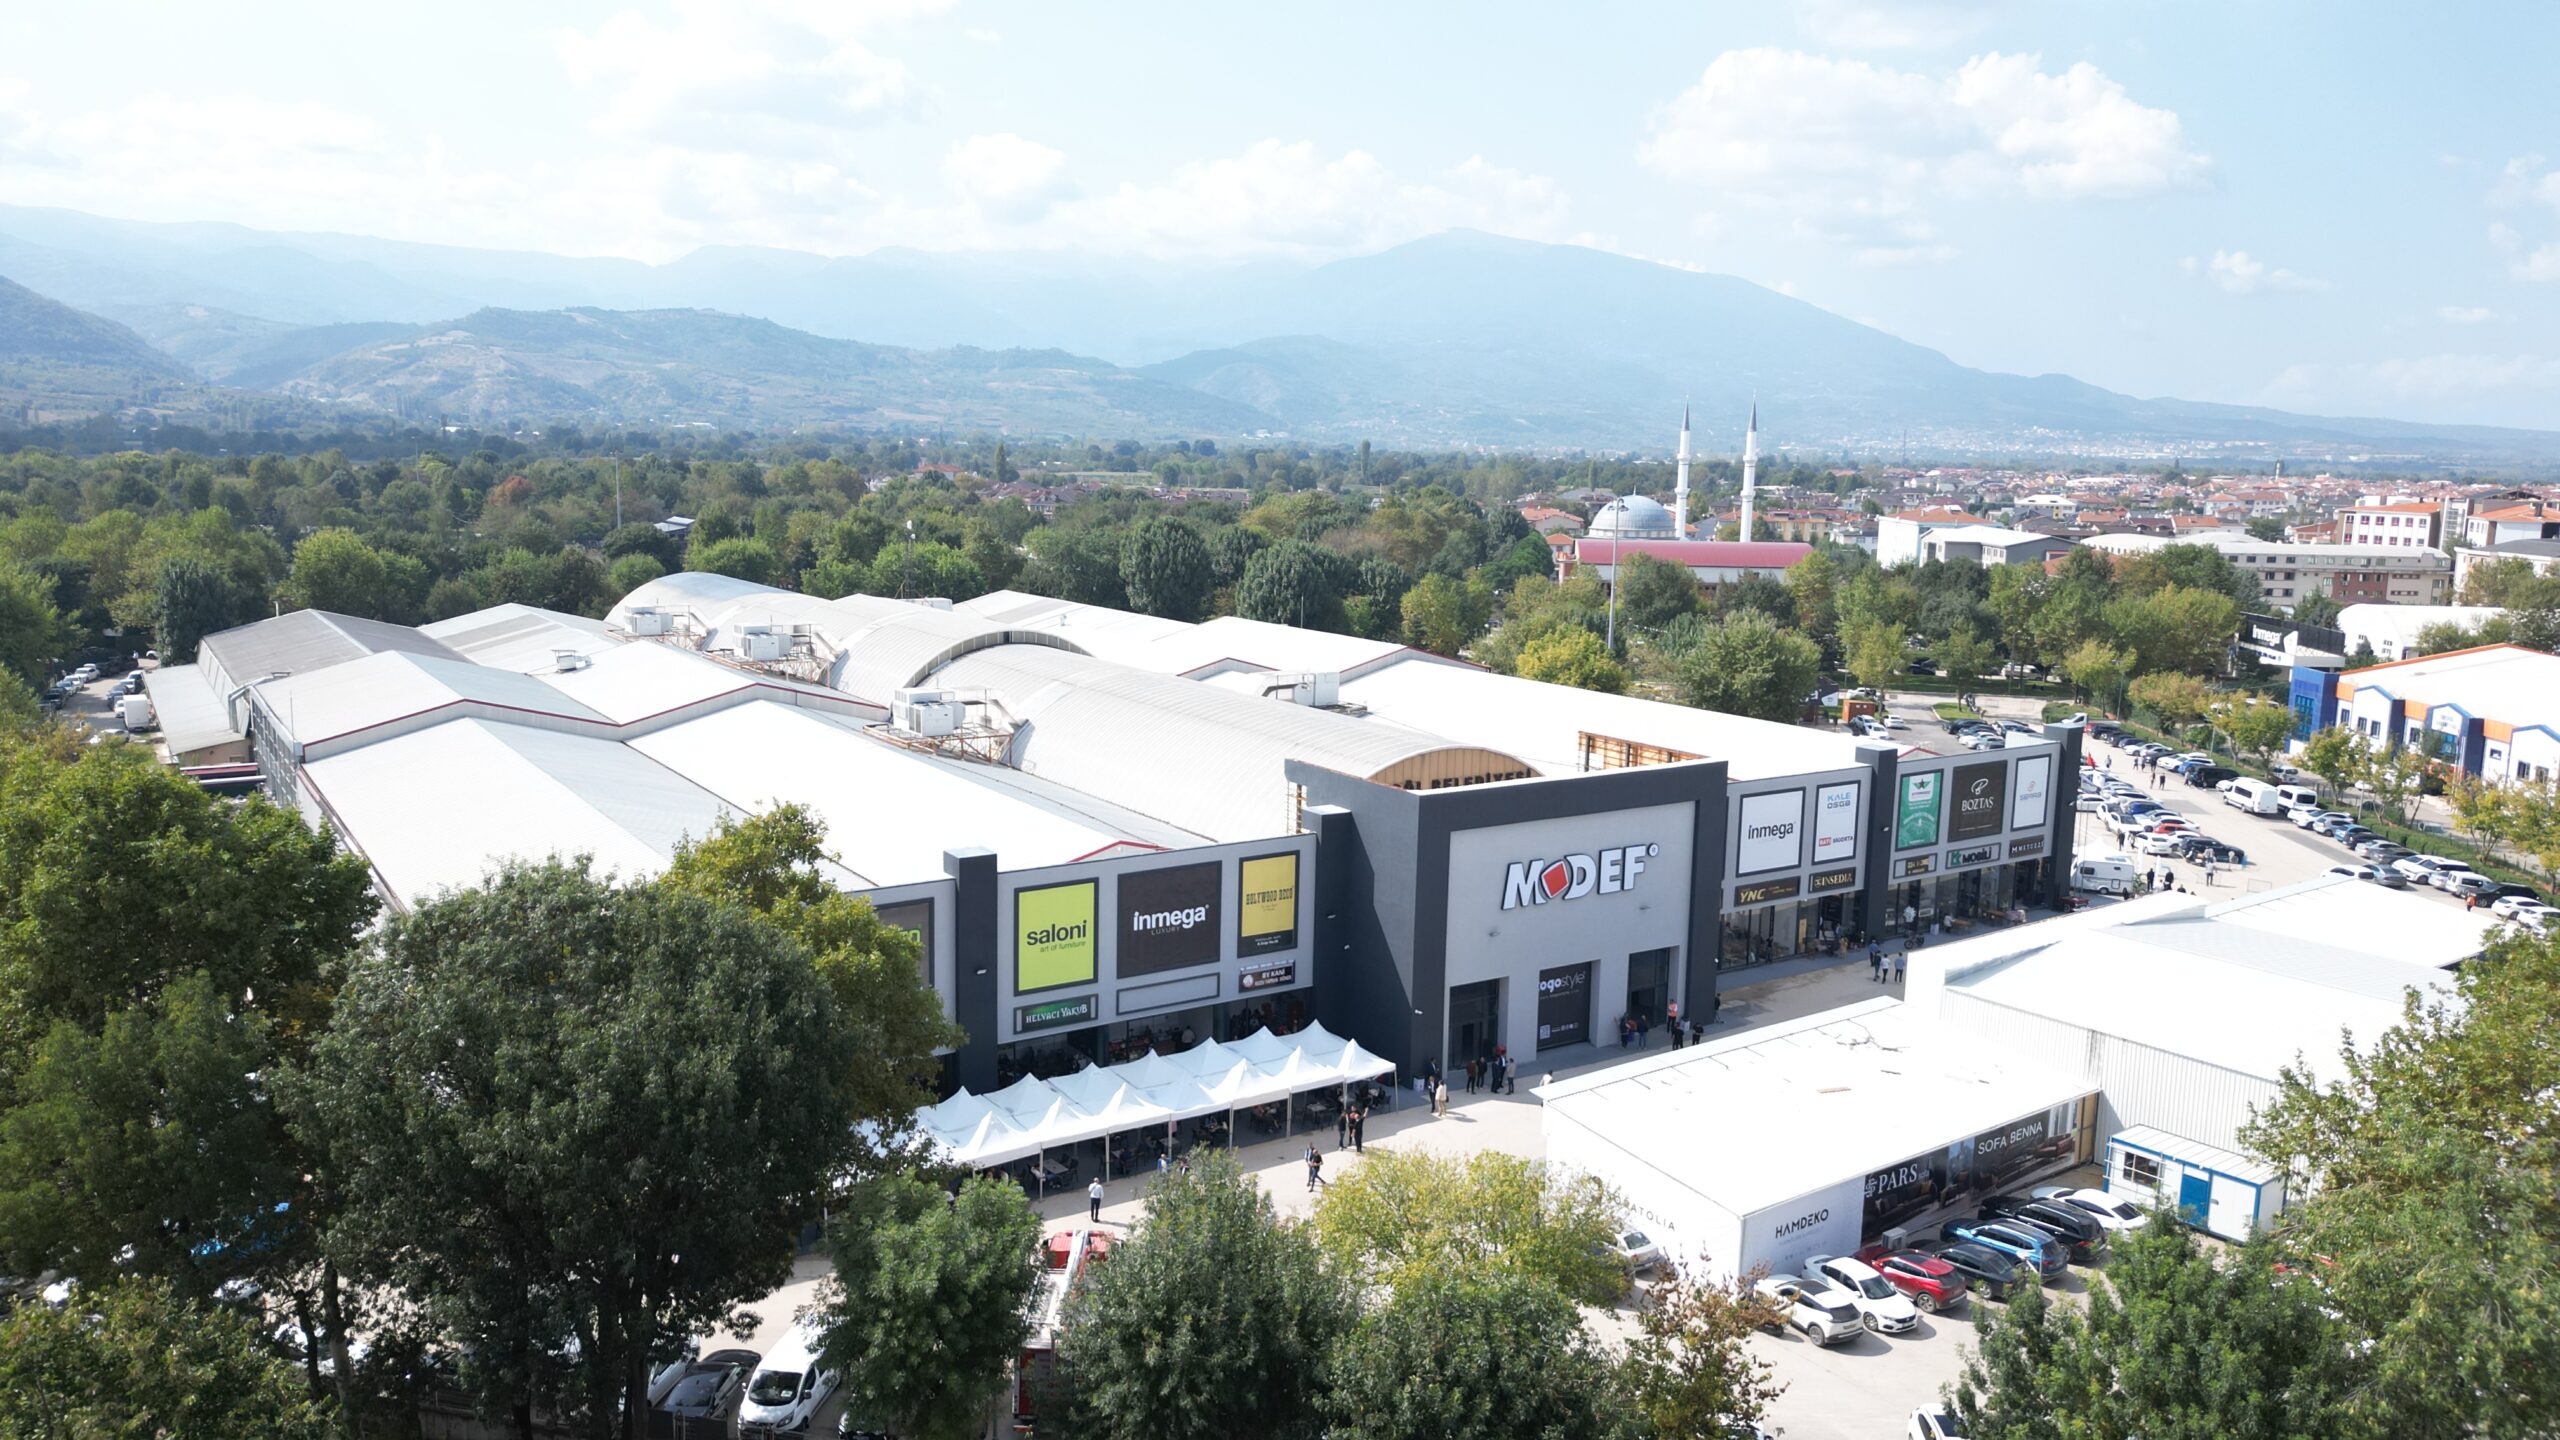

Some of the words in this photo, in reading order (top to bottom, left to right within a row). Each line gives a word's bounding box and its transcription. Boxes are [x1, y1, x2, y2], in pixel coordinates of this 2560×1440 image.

[1748, 822, 1794, 840] inmega
[1740, 889, 1766, 904] YNC
[1133, 909, 1206, 932] inmega
[1026, 920, 1088, 946] saloni
[1026, 1009, 1060, 1024] HELVACI
[1977, 1135, 2007, 1155] SOFA
[2009, 1121, 2043, 1145] BENNA
[1878, 1163, 1918, 1195] PARS
[1775, 1208, 1829, 1239] HAMDEKO
